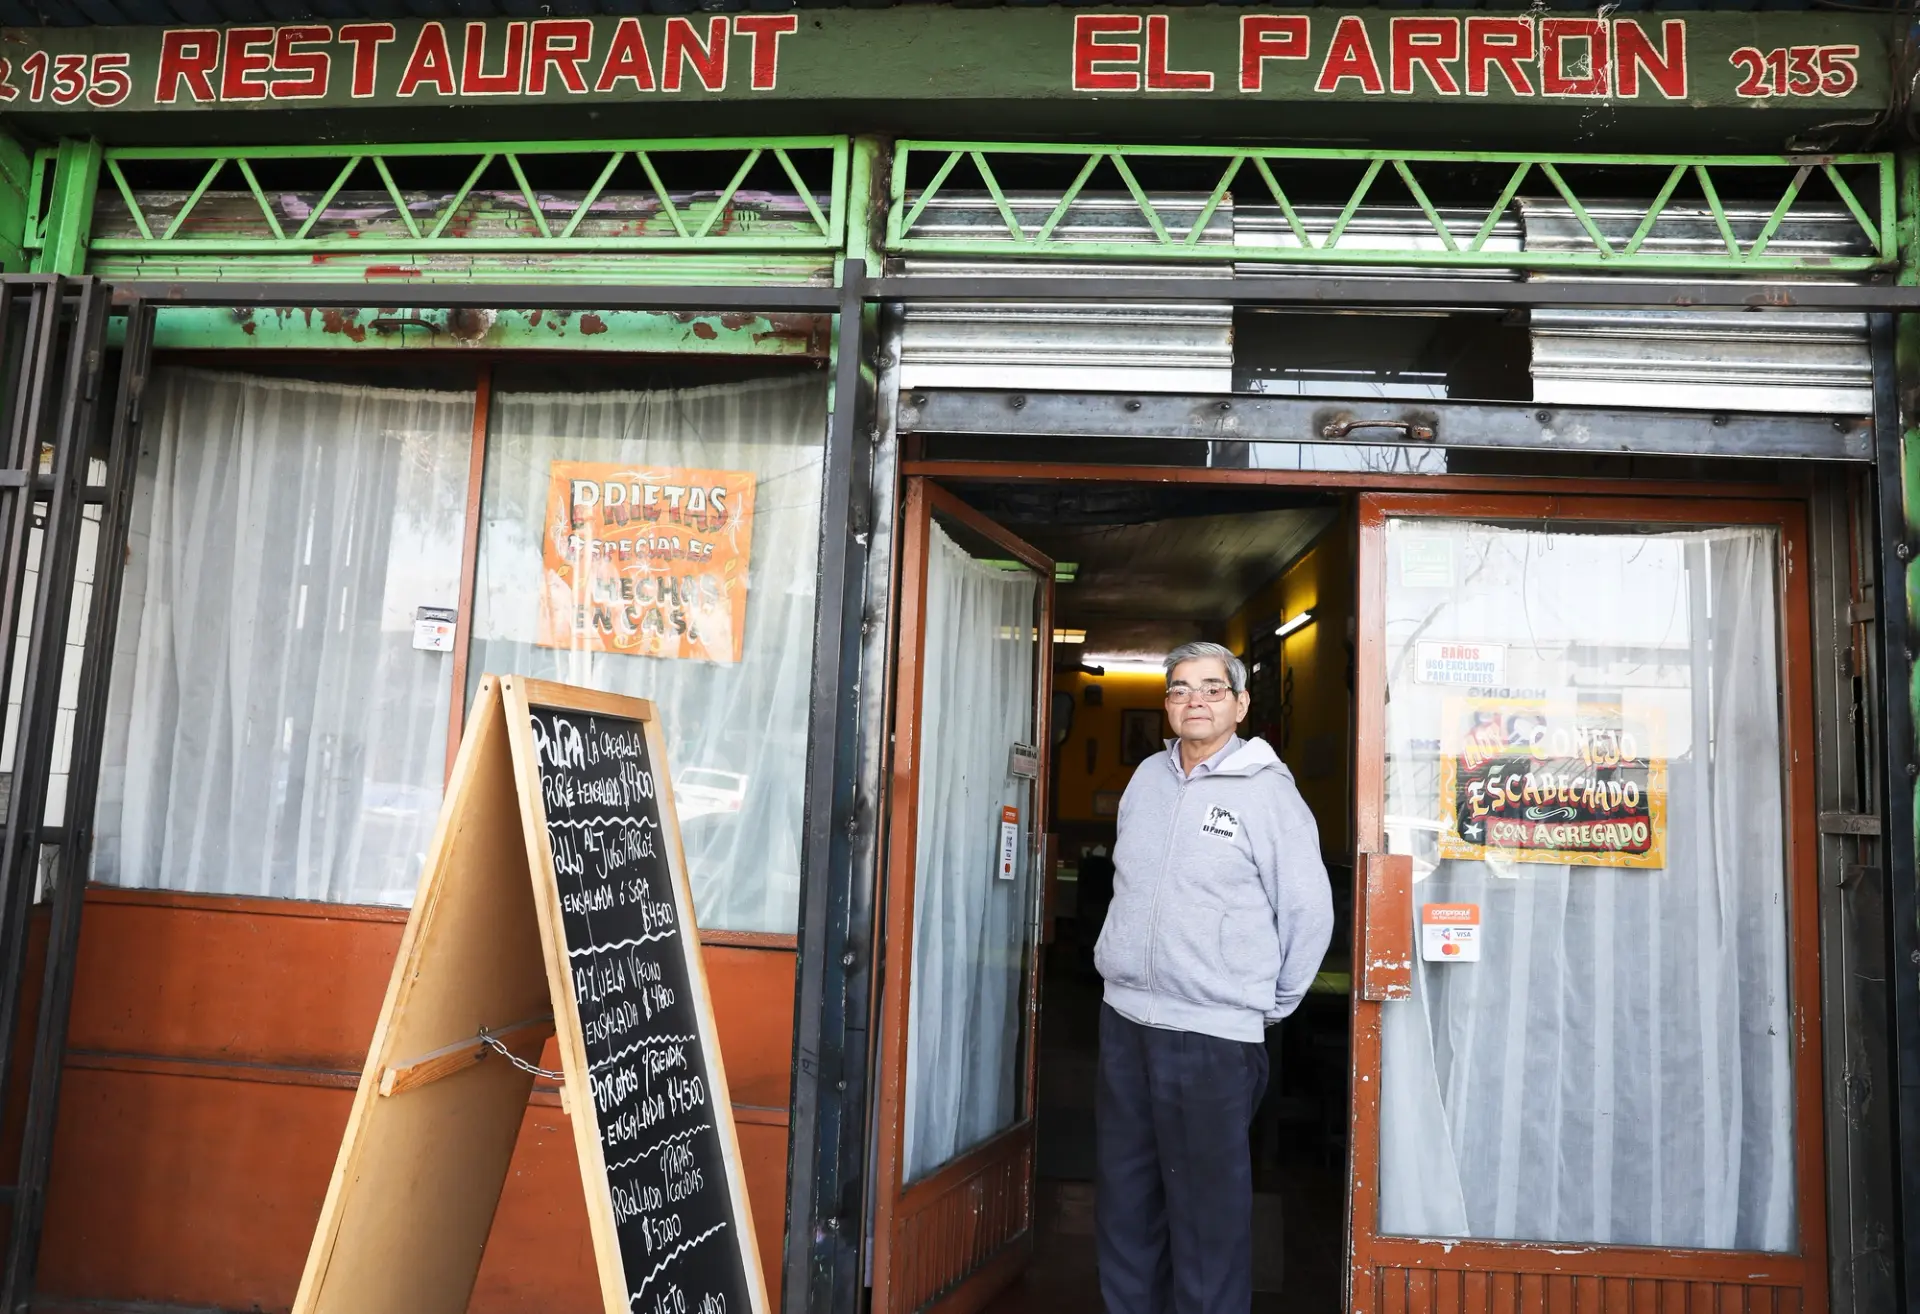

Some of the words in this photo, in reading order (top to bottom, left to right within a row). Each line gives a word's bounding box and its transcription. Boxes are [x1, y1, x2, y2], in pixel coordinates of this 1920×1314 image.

[154, 14, 799, 103] RESTAURANT
[1072, 14, 1214, 92] EL
[1239, 14, 1688, 100] PARRON
[1728, 44, 1860, 98] 2135
[569, 479, 729, 533] PRIETAS
[592, 573, 719, 609] HECHAS
[574, 603, 614, 634] EN
[1425, 659, 1444, 671] USO
[1446, 660, 1495, 673] EXCLUSIVO
[1441, 645, 1480, 661] BAÑOS
[1426, 670, 1450, 682] PARA
[1453, 671, 1494, 684] CLIENTES
[1528, 724, 1638, 768] CONEJO
[1466, 772, 1641, 819] ESCABECHADO
[1203, 824, 1210, 832] El
[1491, 821, 1529, 843] CON
[1533, 821, 1649, 850] AGREGADO
[563, 883, 615, 916] ENSALADA
[585, 1000, 640, 1046] ENSALADA
